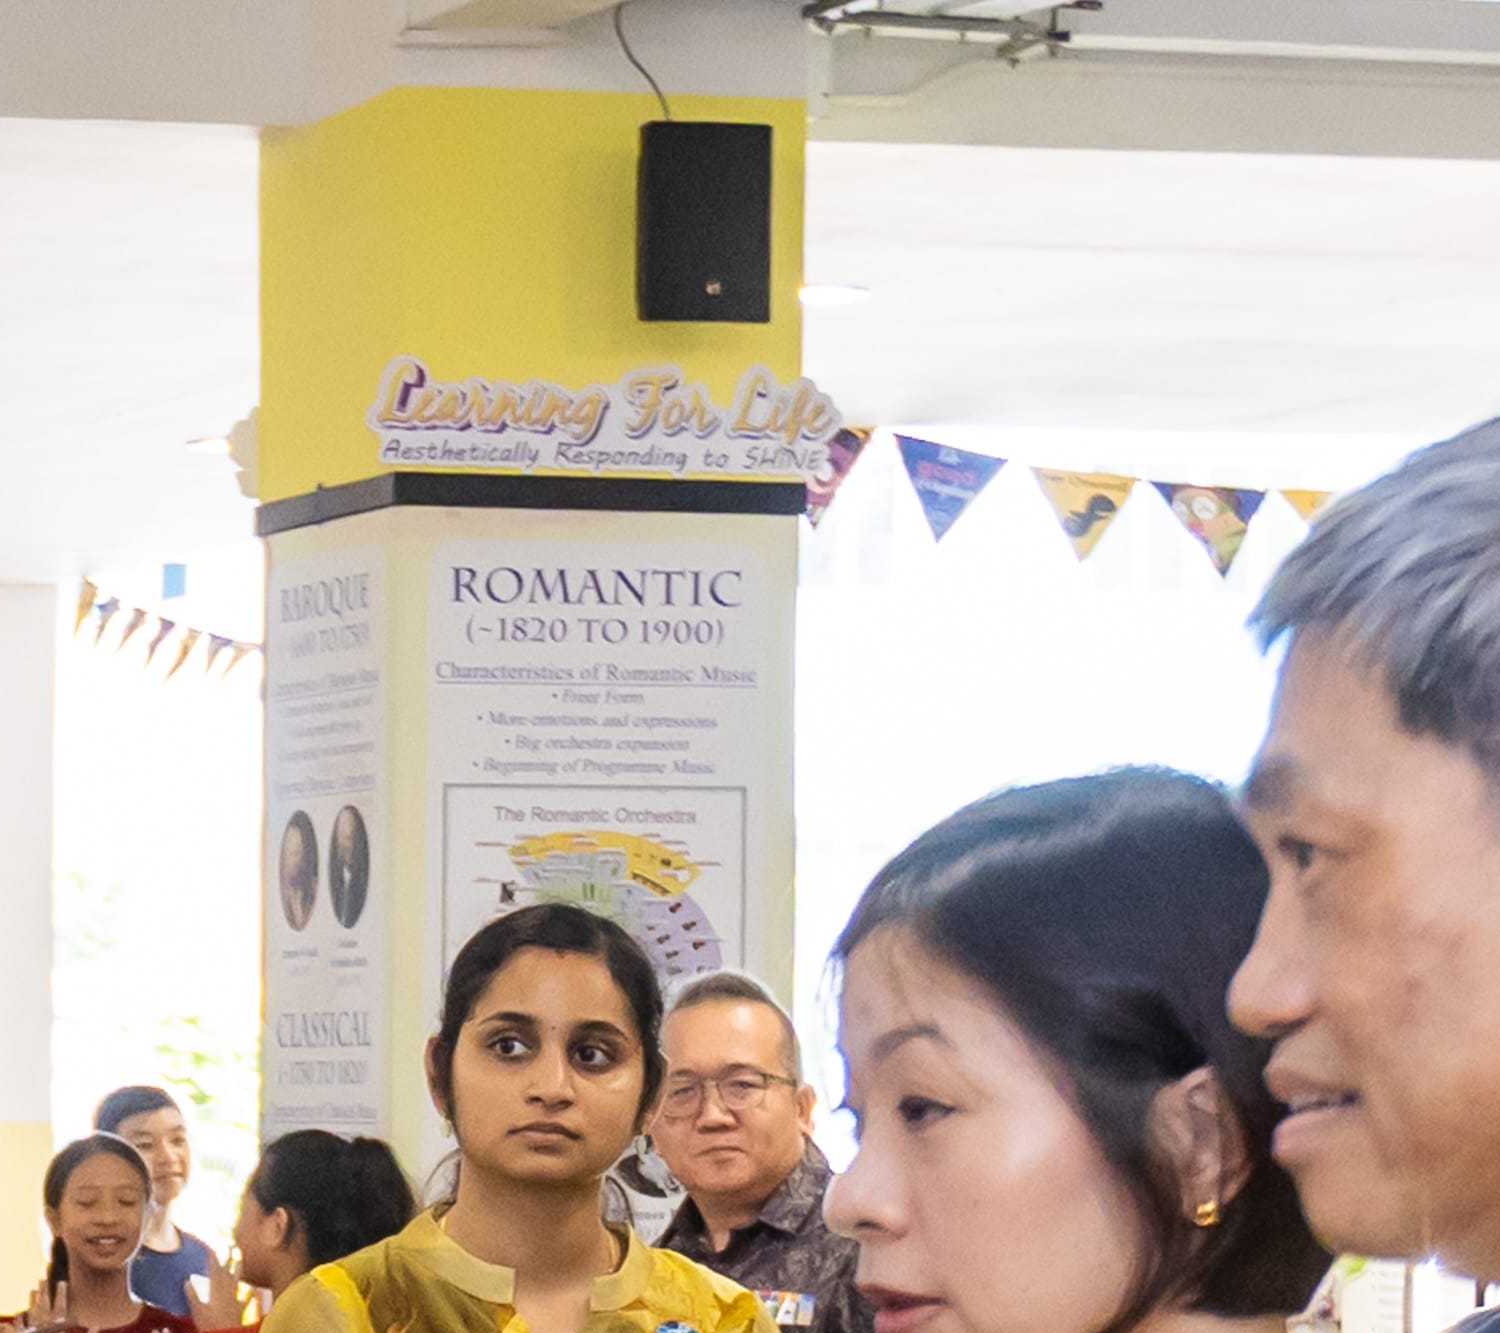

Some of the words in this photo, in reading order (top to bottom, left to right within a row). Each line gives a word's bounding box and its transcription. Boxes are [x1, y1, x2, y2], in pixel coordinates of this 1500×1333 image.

[379, 358, 608, 444] Learning
[625, 372, 720, 438] For
[727, 373, 831, 444] Life
[382, 438, 540, 473] Aesthetically
[554, 442, 687, 472] Responding
[702, 446, 729, 469] to
[451, 566, 743, 607] ROMANTIC
[466, 615, 568, 644] (~1820
[577, 617, 628, 645] TO
[640, 618, 726, 648] 1900)
[435, 660, 574, 681] Characteristics
[579, 662, 600, 681] of
[606, 662, 694, 682] Romantic
[701, 664, 757, 684] Music
[493, 806, 526, 822] The
[530, 806, 610, 823] Romantic
[614, 806, 698, 824] Orchestra
[276, 1010, 371, 1049] CLASSICAL
